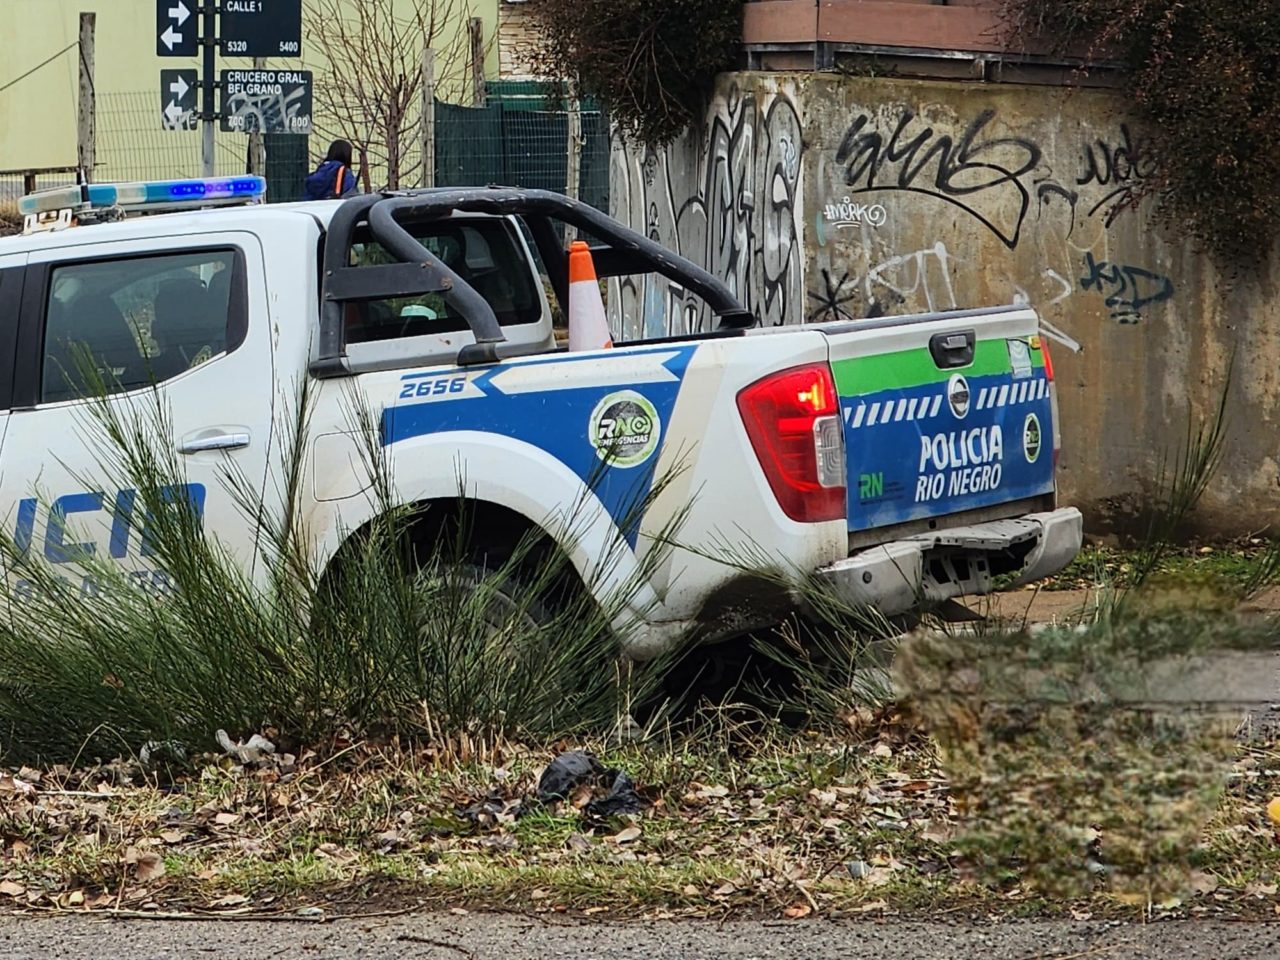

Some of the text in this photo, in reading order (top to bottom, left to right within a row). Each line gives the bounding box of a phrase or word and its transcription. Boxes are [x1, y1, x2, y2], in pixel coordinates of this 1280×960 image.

[226, 0, 263, 13] CALLE 1
[227, 41, 247, 52] 5320
[279, 41, 299, 52] 5400
[227, 71, 308, 84] CRUCERO GRAL.
[227, 83, 282, 95] BELGRANO
[399, 377, 466, 399] 2656
[919, 425, 1003, 473] POLICIA
[859, 471, 884, 499] RN
[915, 473, 945, 502] RIO
[948, 463, 1002, 497] NEGRO
